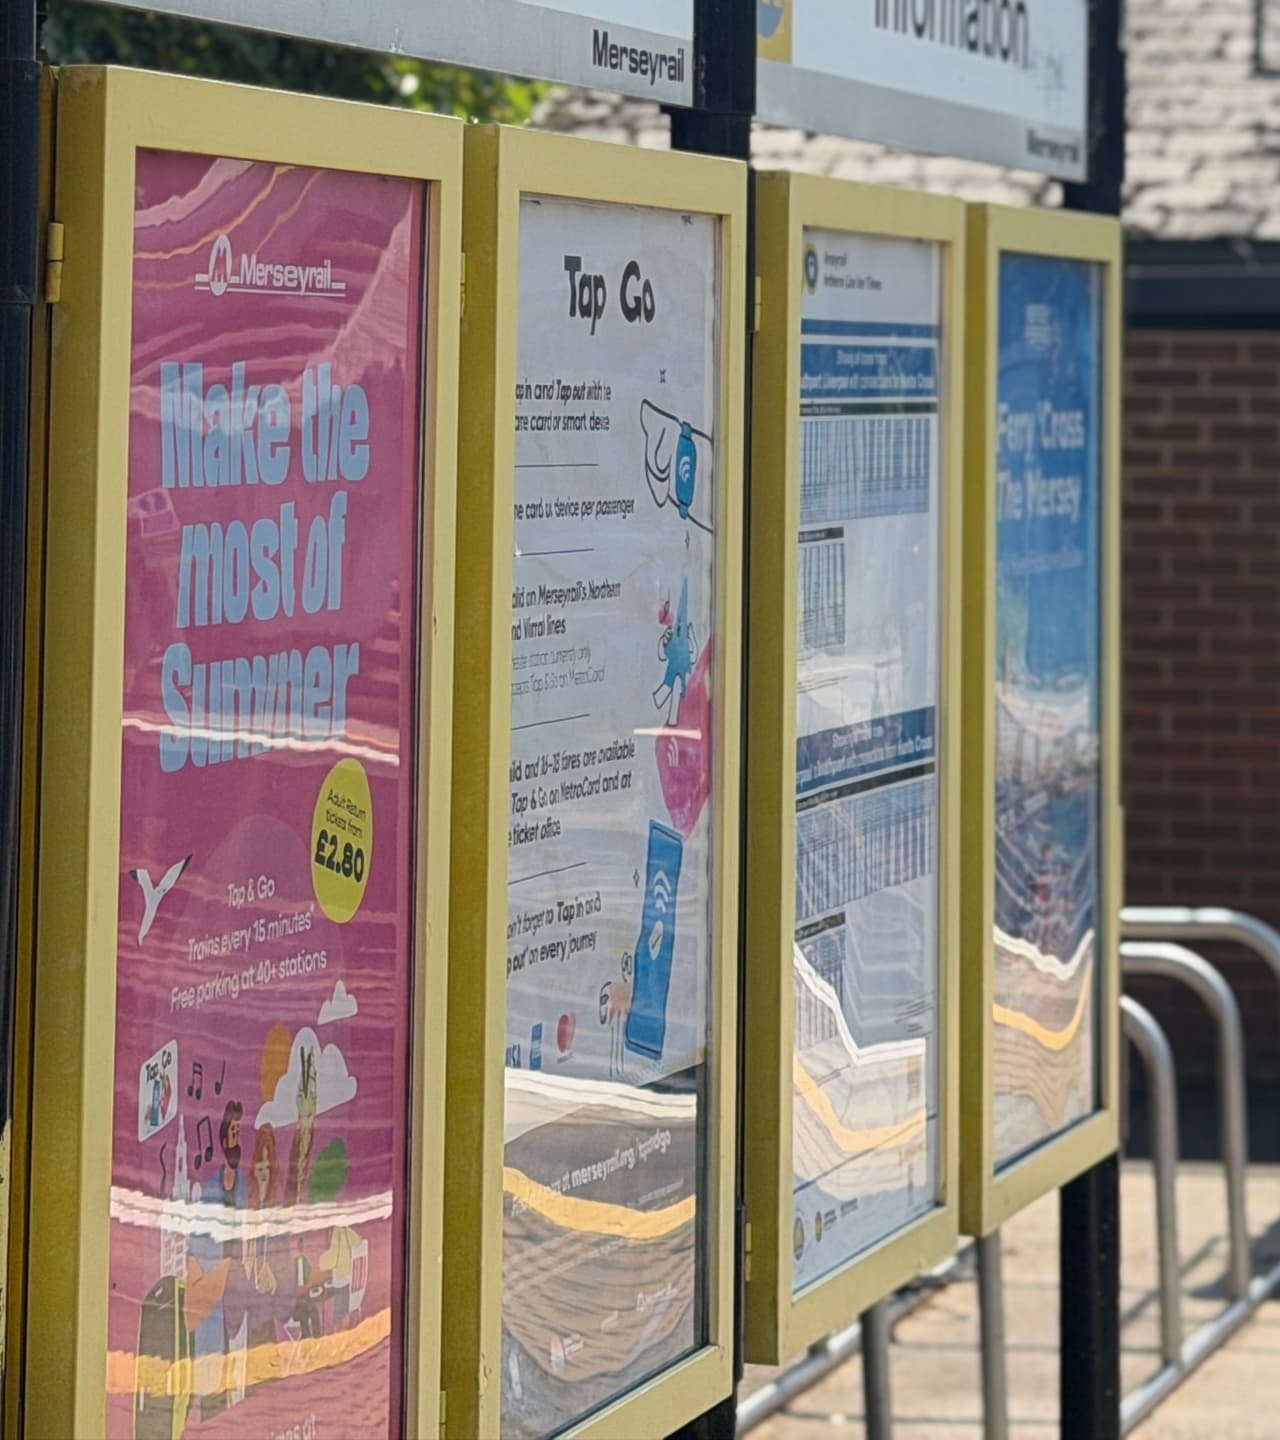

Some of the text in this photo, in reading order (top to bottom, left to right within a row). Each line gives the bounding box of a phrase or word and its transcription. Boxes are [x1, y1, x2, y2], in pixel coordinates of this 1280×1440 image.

[592, 28, 685, 86] Merseyrail
[240, 253, 332, 295] Merseyrail
[563, 255, 656, 336] Tap Go
[534, 380, 555, 400] and
[556, 378, 572, 406] Tap
[159, 361, 370, 488] Make the
[176, 490, 348, 628] most of
[511, 617, 522, 640] nd
[159, 641, 360, 773] Summer
[512, 792, 528, 818] Tap
[602, 768, 619, 793] and
[621, 768, 632, 789] at
[314, 828, 365, 883] £2.80
[512, 821, 539, 846] ticket
[228, 875, 276, 909] Tap & Go
[556, 901, 575, 926] Tap
[188, 933, 220, 961] Trains
[221, 927, 252, 953] every
[253, 918, 266, 942] 15
[540, 938, 567, 962] every
[170, 950, 328, 1012] Free parking at 40+ stations
